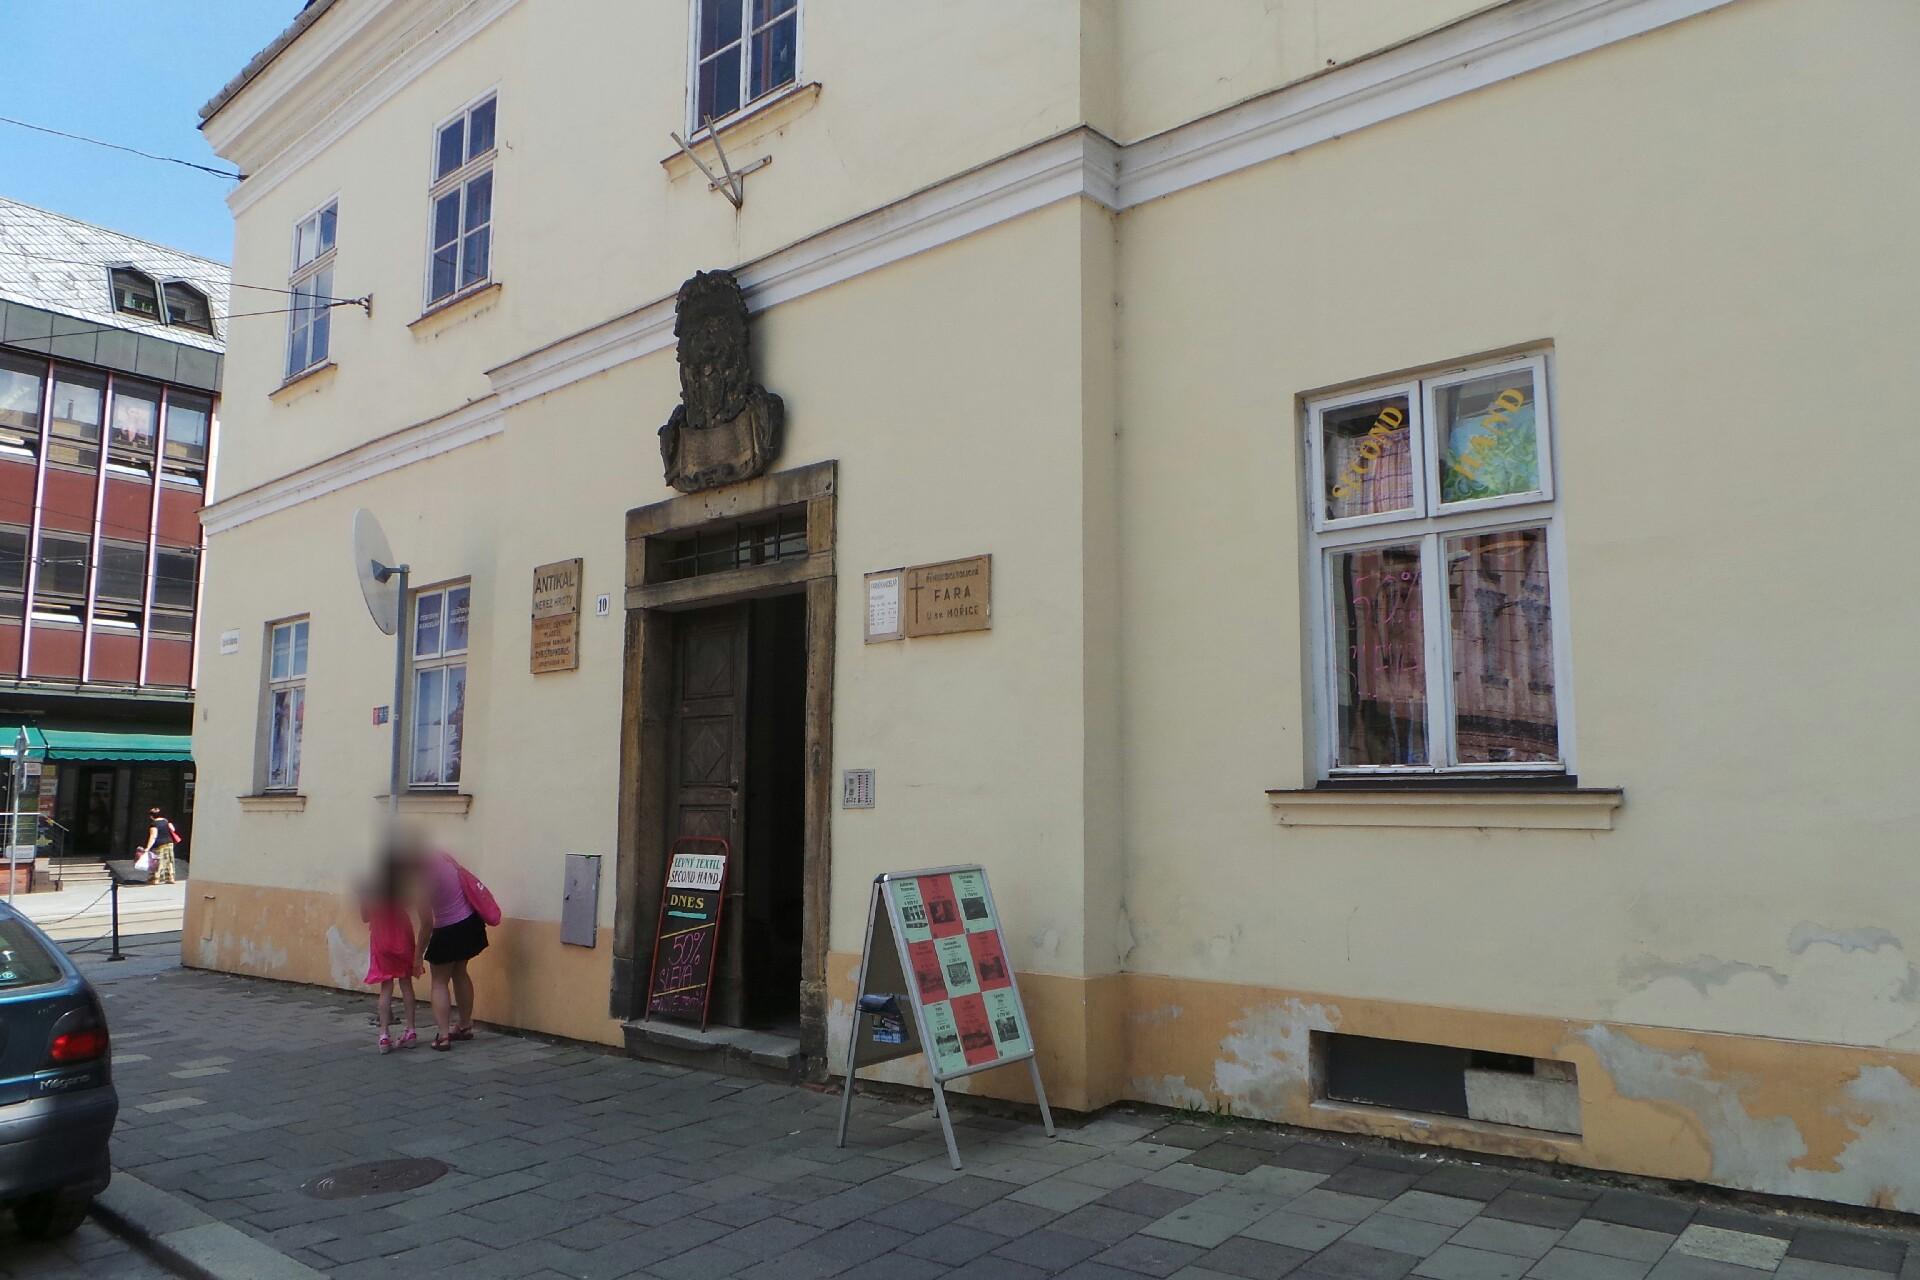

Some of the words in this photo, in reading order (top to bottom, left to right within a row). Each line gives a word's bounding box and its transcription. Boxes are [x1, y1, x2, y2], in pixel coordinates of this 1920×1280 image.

[535, 572, 575, 594] ANTIKAL
[934, 585, 971, 603] FARA
[599, 598, 608, 613] 10
[947, 604, 979, 618] MOŘICE
[696, 858, 721, 870] TEXTIL
[670, 870, 696, 884] SECOND
[697, 872, 719, 885] HAND
[670, 894, 704, 909] DNES
[669, 932, 706, 965] 50%
